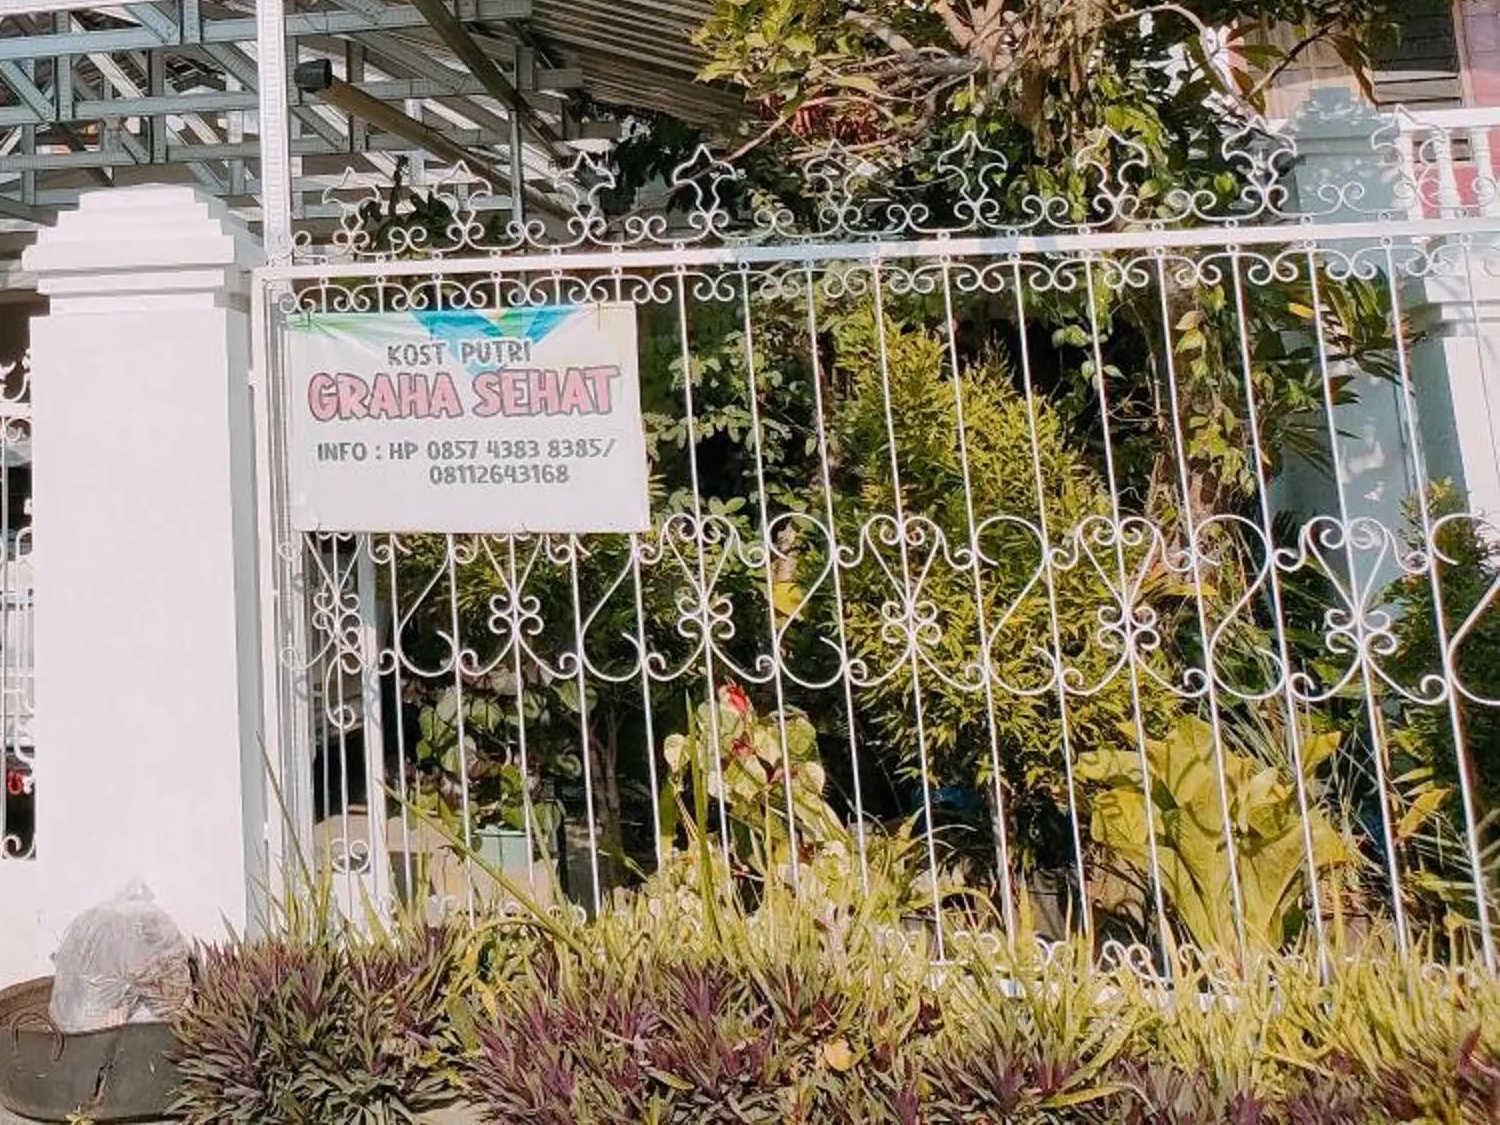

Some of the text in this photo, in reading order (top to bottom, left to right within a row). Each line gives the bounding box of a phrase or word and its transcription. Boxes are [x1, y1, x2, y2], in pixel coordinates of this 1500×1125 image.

[387, 339, 531, 367] KOST PUTRI
[308, 366, 620, 421] GRAHA SEHAT
[317, 438, 617, 462] INFO : HP 0857 4383 8385/
[429, 464, 570, 485] 08112643168
